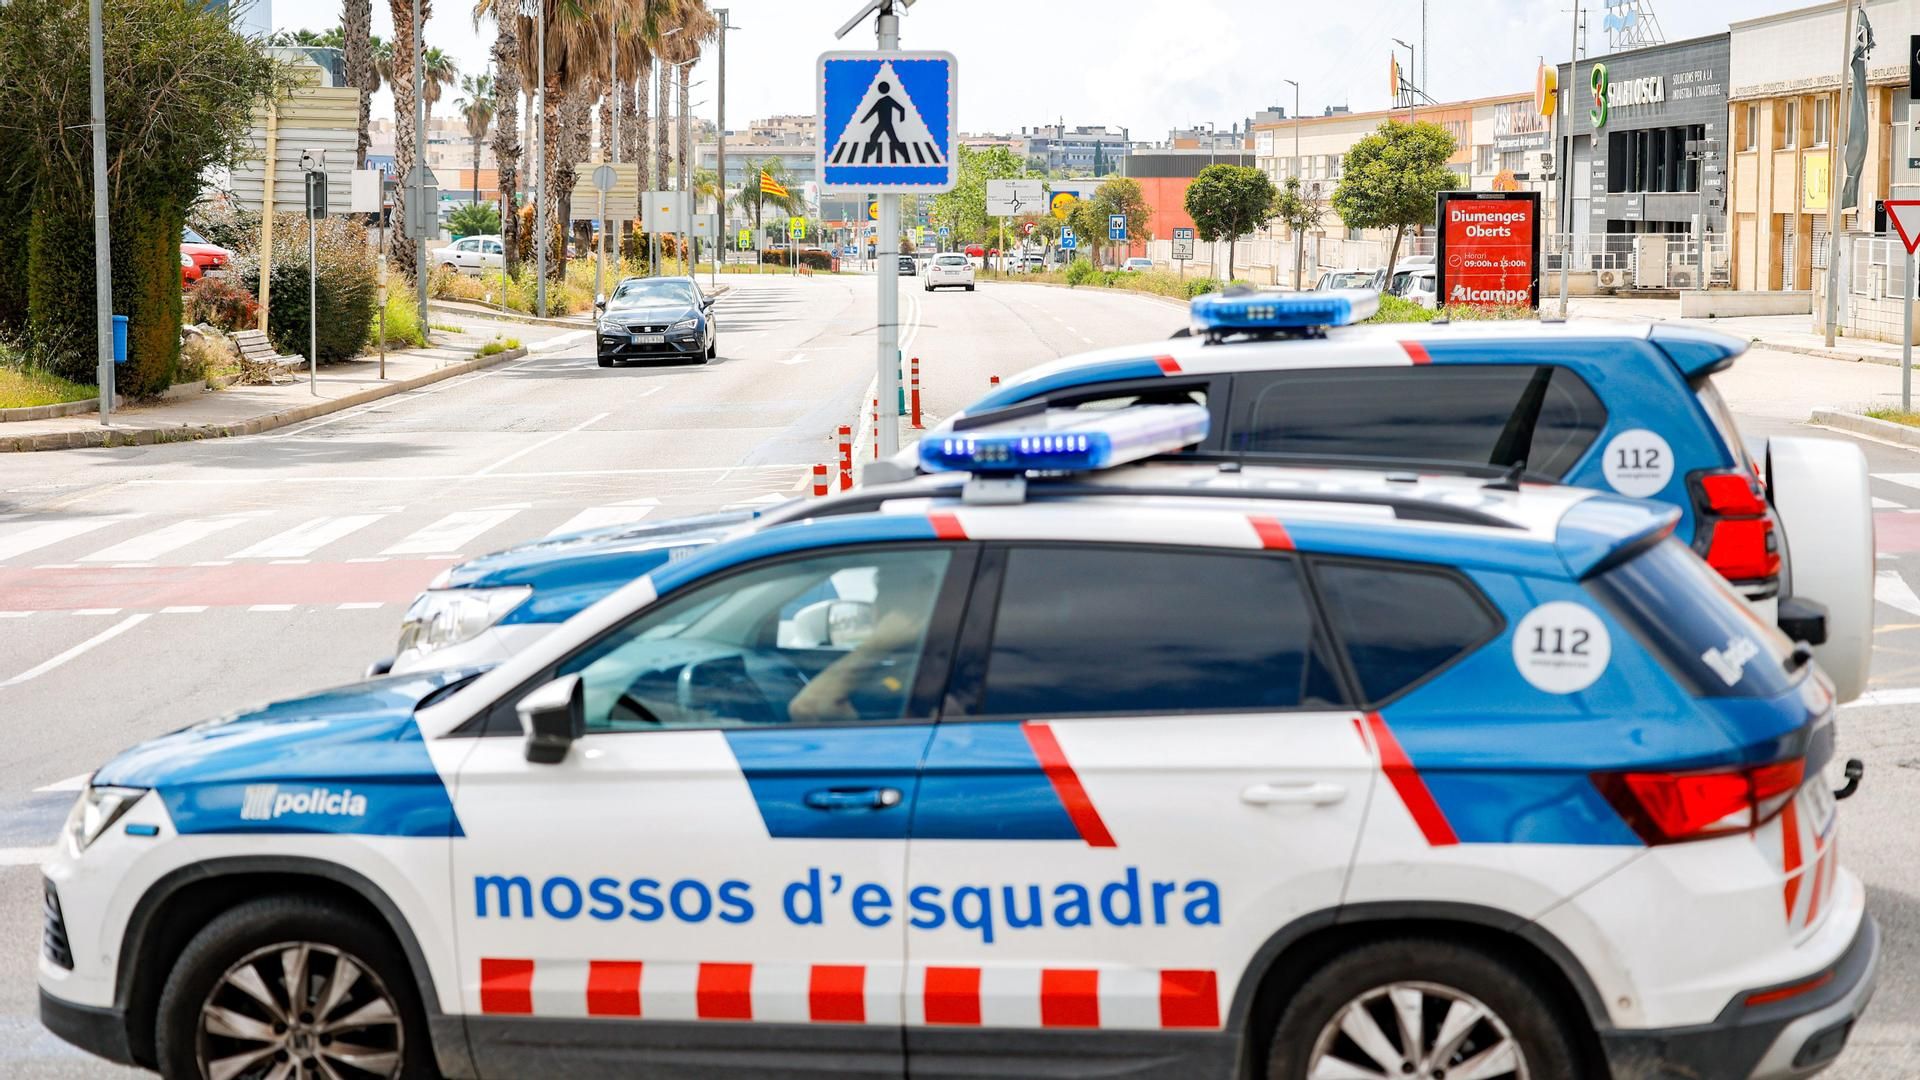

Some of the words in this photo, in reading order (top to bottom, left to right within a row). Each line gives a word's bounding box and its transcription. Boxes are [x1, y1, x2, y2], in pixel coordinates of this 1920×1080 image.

[1451, 210, 1526, 225] Diumenges
[1466, 225, 1511, 237] Oberts
[1464, 252, 1487, 260] Horari
[1464, 260, 1492, 268] 09:00h
[1499, 260, 1527, 268] 15:00h
[1450, 284, 1528, 303] Alcampo
[1617, 448, 1660, 470] 112
[1532, 626, 1590, 655] 112
[273, 788, 368, 818] policia
[474, 874, 755, 925] mossos
[782, 866, 1222, 944] d'esquadra
